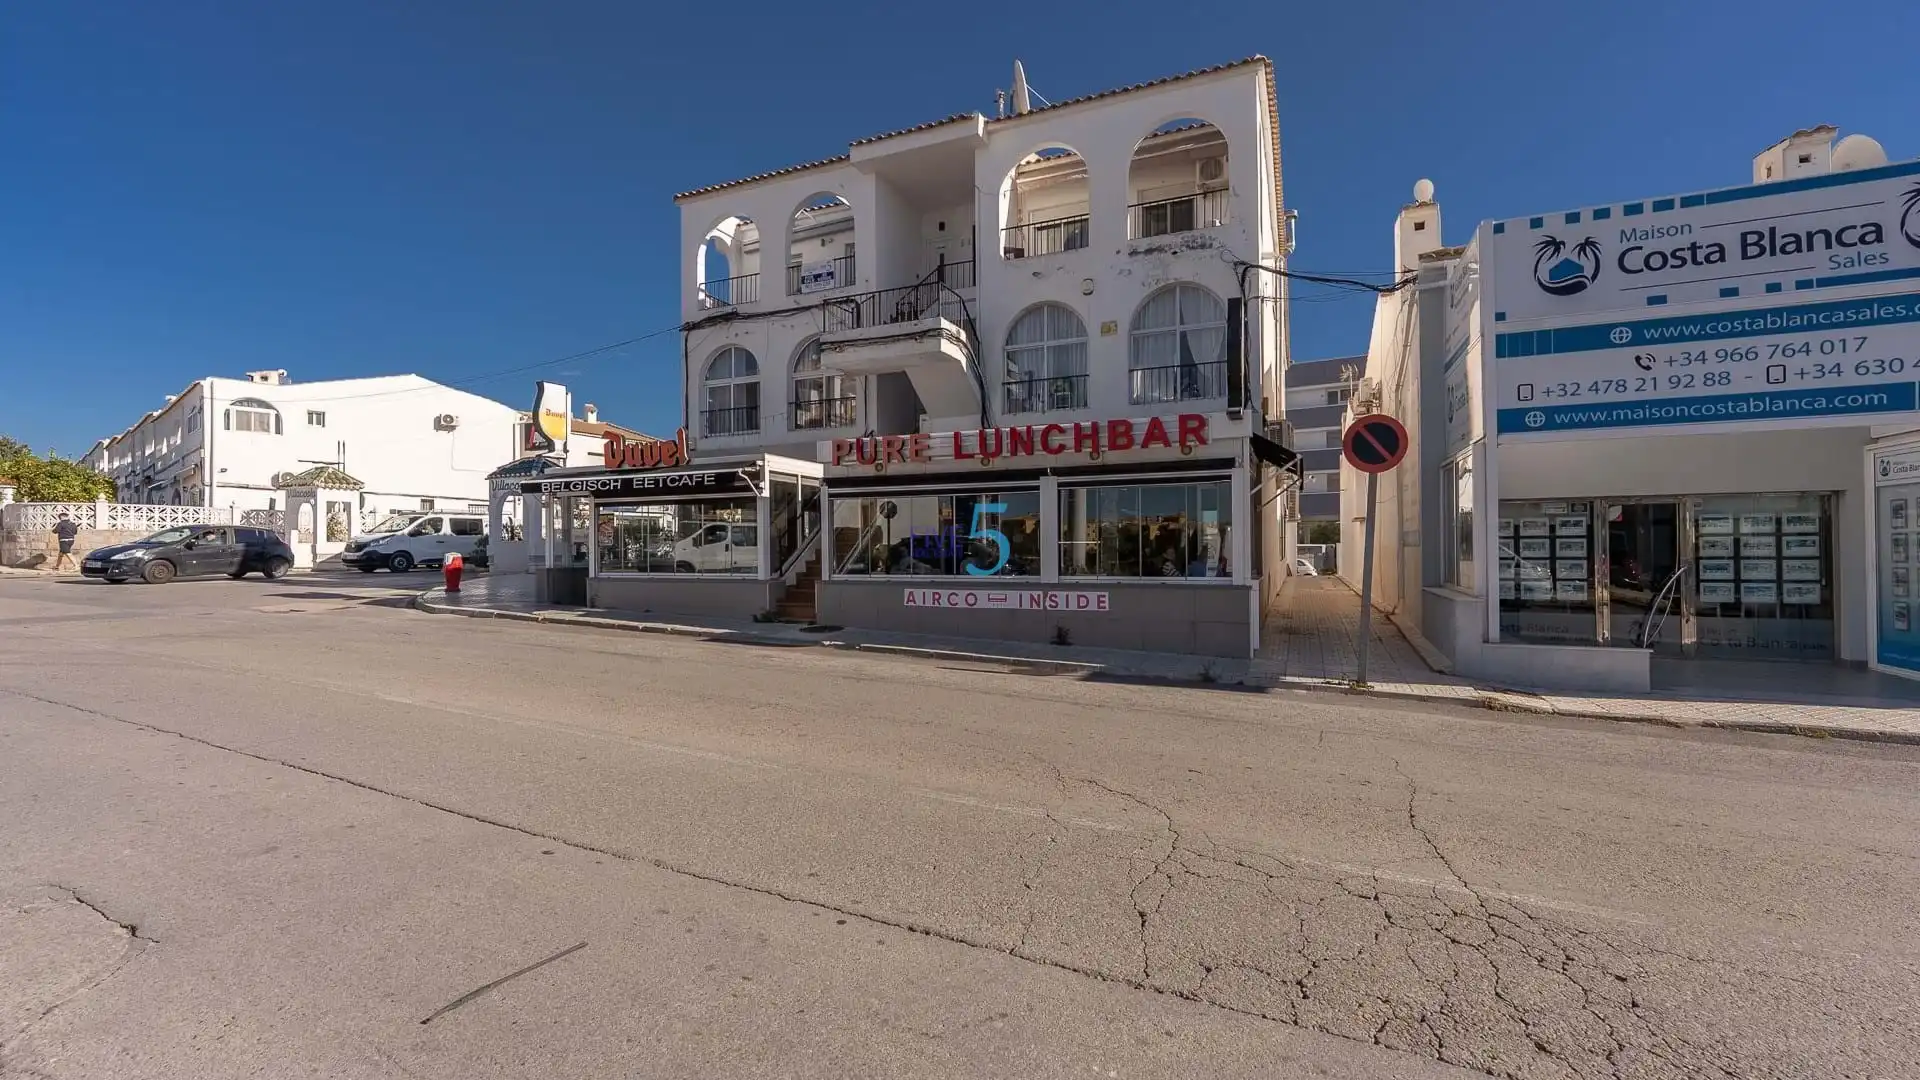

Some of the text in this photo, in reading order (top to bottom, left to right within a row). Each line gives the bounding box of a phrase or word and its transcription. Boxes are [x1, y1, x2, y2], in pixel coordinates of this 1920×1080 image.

[1617, 221, 1885, 275] Costa Blanca
[1619, 222, 1693, 244] Maison
[1828, 251, 1890, 270] Sales
[1663, 336, 1869, 368] +34 966 764 017
[1541, 382, 1582, 399] +32
[1587, 378, 1628, 395] 478
[1634, 376, 1658, 393] 21
[1668, 373, 1696, 390] 92
[1703, 371, 1732, 387] 88
[1793, 362, 1845, 381] +34
[1854, 357, 1905, 377] 630
[545, 408, 566, 419] Duvel
[1554, 392, 1888, 424] www.maisoncostablanca.com
[603, 426, 691, 471] Duvel
[831, 413, 1209, 467] PURE LUNCHBAR
[541, 474, 716, 493] BELGISCH EETCAFE
[905, 591, 1107, 610] AIRCO INSIDE
